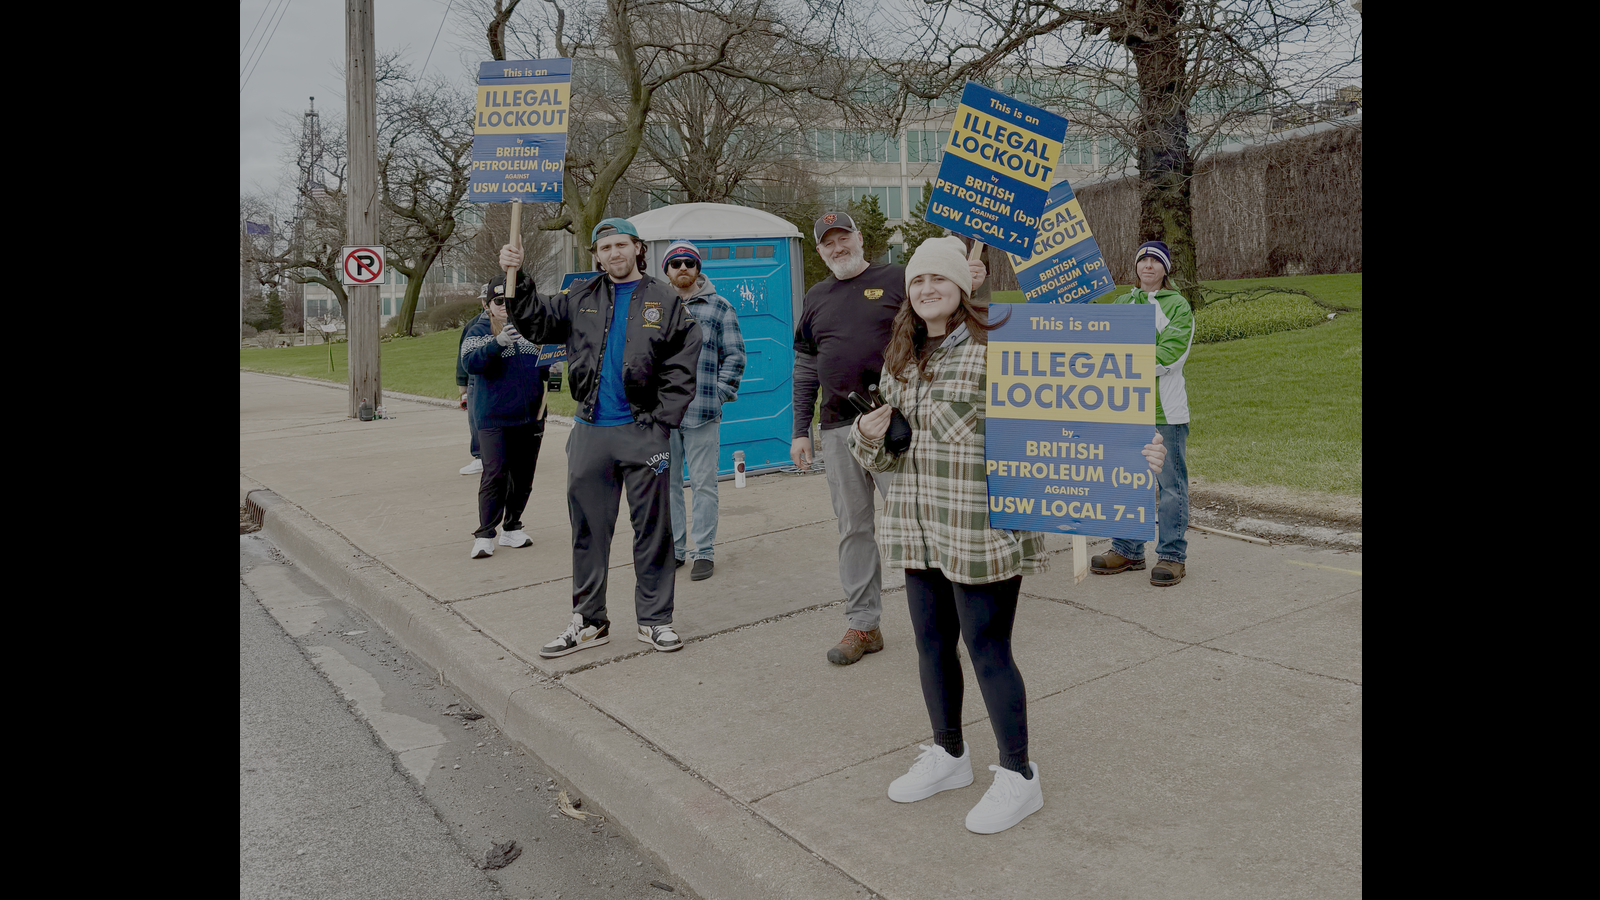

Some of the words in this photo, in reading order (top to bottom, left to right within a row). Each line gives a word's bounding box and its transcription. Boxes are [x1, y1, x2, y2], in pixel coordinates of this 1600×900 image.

[503, 68, 522, 77] This
[525, 68, 533, 76] is
[485, 89, 562, 108] ILLEGAL
[478, 110, 566, 127] LOCKOUT
[990, 98, 1011, 114] This
[1013, 108, 1022, 119] is
[1025, 115, 1040, 126] an
[963, 112, 1050, 162] ILLEGAL
[496, 146, 539, 157] BRITISH
[951, 130, 1052, 182] LOCKOUT
[472, 160, 538, 170] PETROLEUM
[541, 160, 564, 172] (bp)
[473, 182, 499, 193] USW
[502, 182, 537, 192] LOCAL
[540, 182, 558, 192] 7-1
[965, 175, 1015, 203] BRITISH
[990, 175, 999, 184] by
[936, 178, 1010, 216] PETROLEUM
[1014, 209, 1040, 229] (bp)
[970, 206, 1000, 222] AGAINST
[932, 202, 963, 222] USW
[964, 216, 1005, 239] LOCAL
[1009, 232, 1030, 248] 7-1
[1025, 268, 1082, 301] PETROLEUM
[1083, 257, 1104, 274] (bp)
[1039, 257, 1077, 282] BRITISH
[1057, 281, 1078, 294] AGAINST
[1058, 285, 1090, 304] LOCAL
[1091, 276, 1108, 290] 7-1
[1030, 316, 1064, 331] This
[1069, 317, 1082, 331] is
[1088, 320, 1110, 331] an
[540, 352, 554, 360] USW
[554, 350, 566, 358] LOC
[1001, 350, 1142, 380] ILLEGAL
[991, 382, 1151, 412] LOCKOUT
[1062, 428, 1074, 438] by
[646, 452, 670, 466] LIONS
[1026, 440, 1104, 460] BRITISH
[986, 460, 1104, 482] PETROLEUM
[1112, 466, 1154, 490] (bp)
[1044, 485, 1090, 496] AGAINST
[990, 496, 1035, 514] USW
[1042, 500, 1106, 520] LOCAL
[1114, 504, 1145, 523] 7-1
